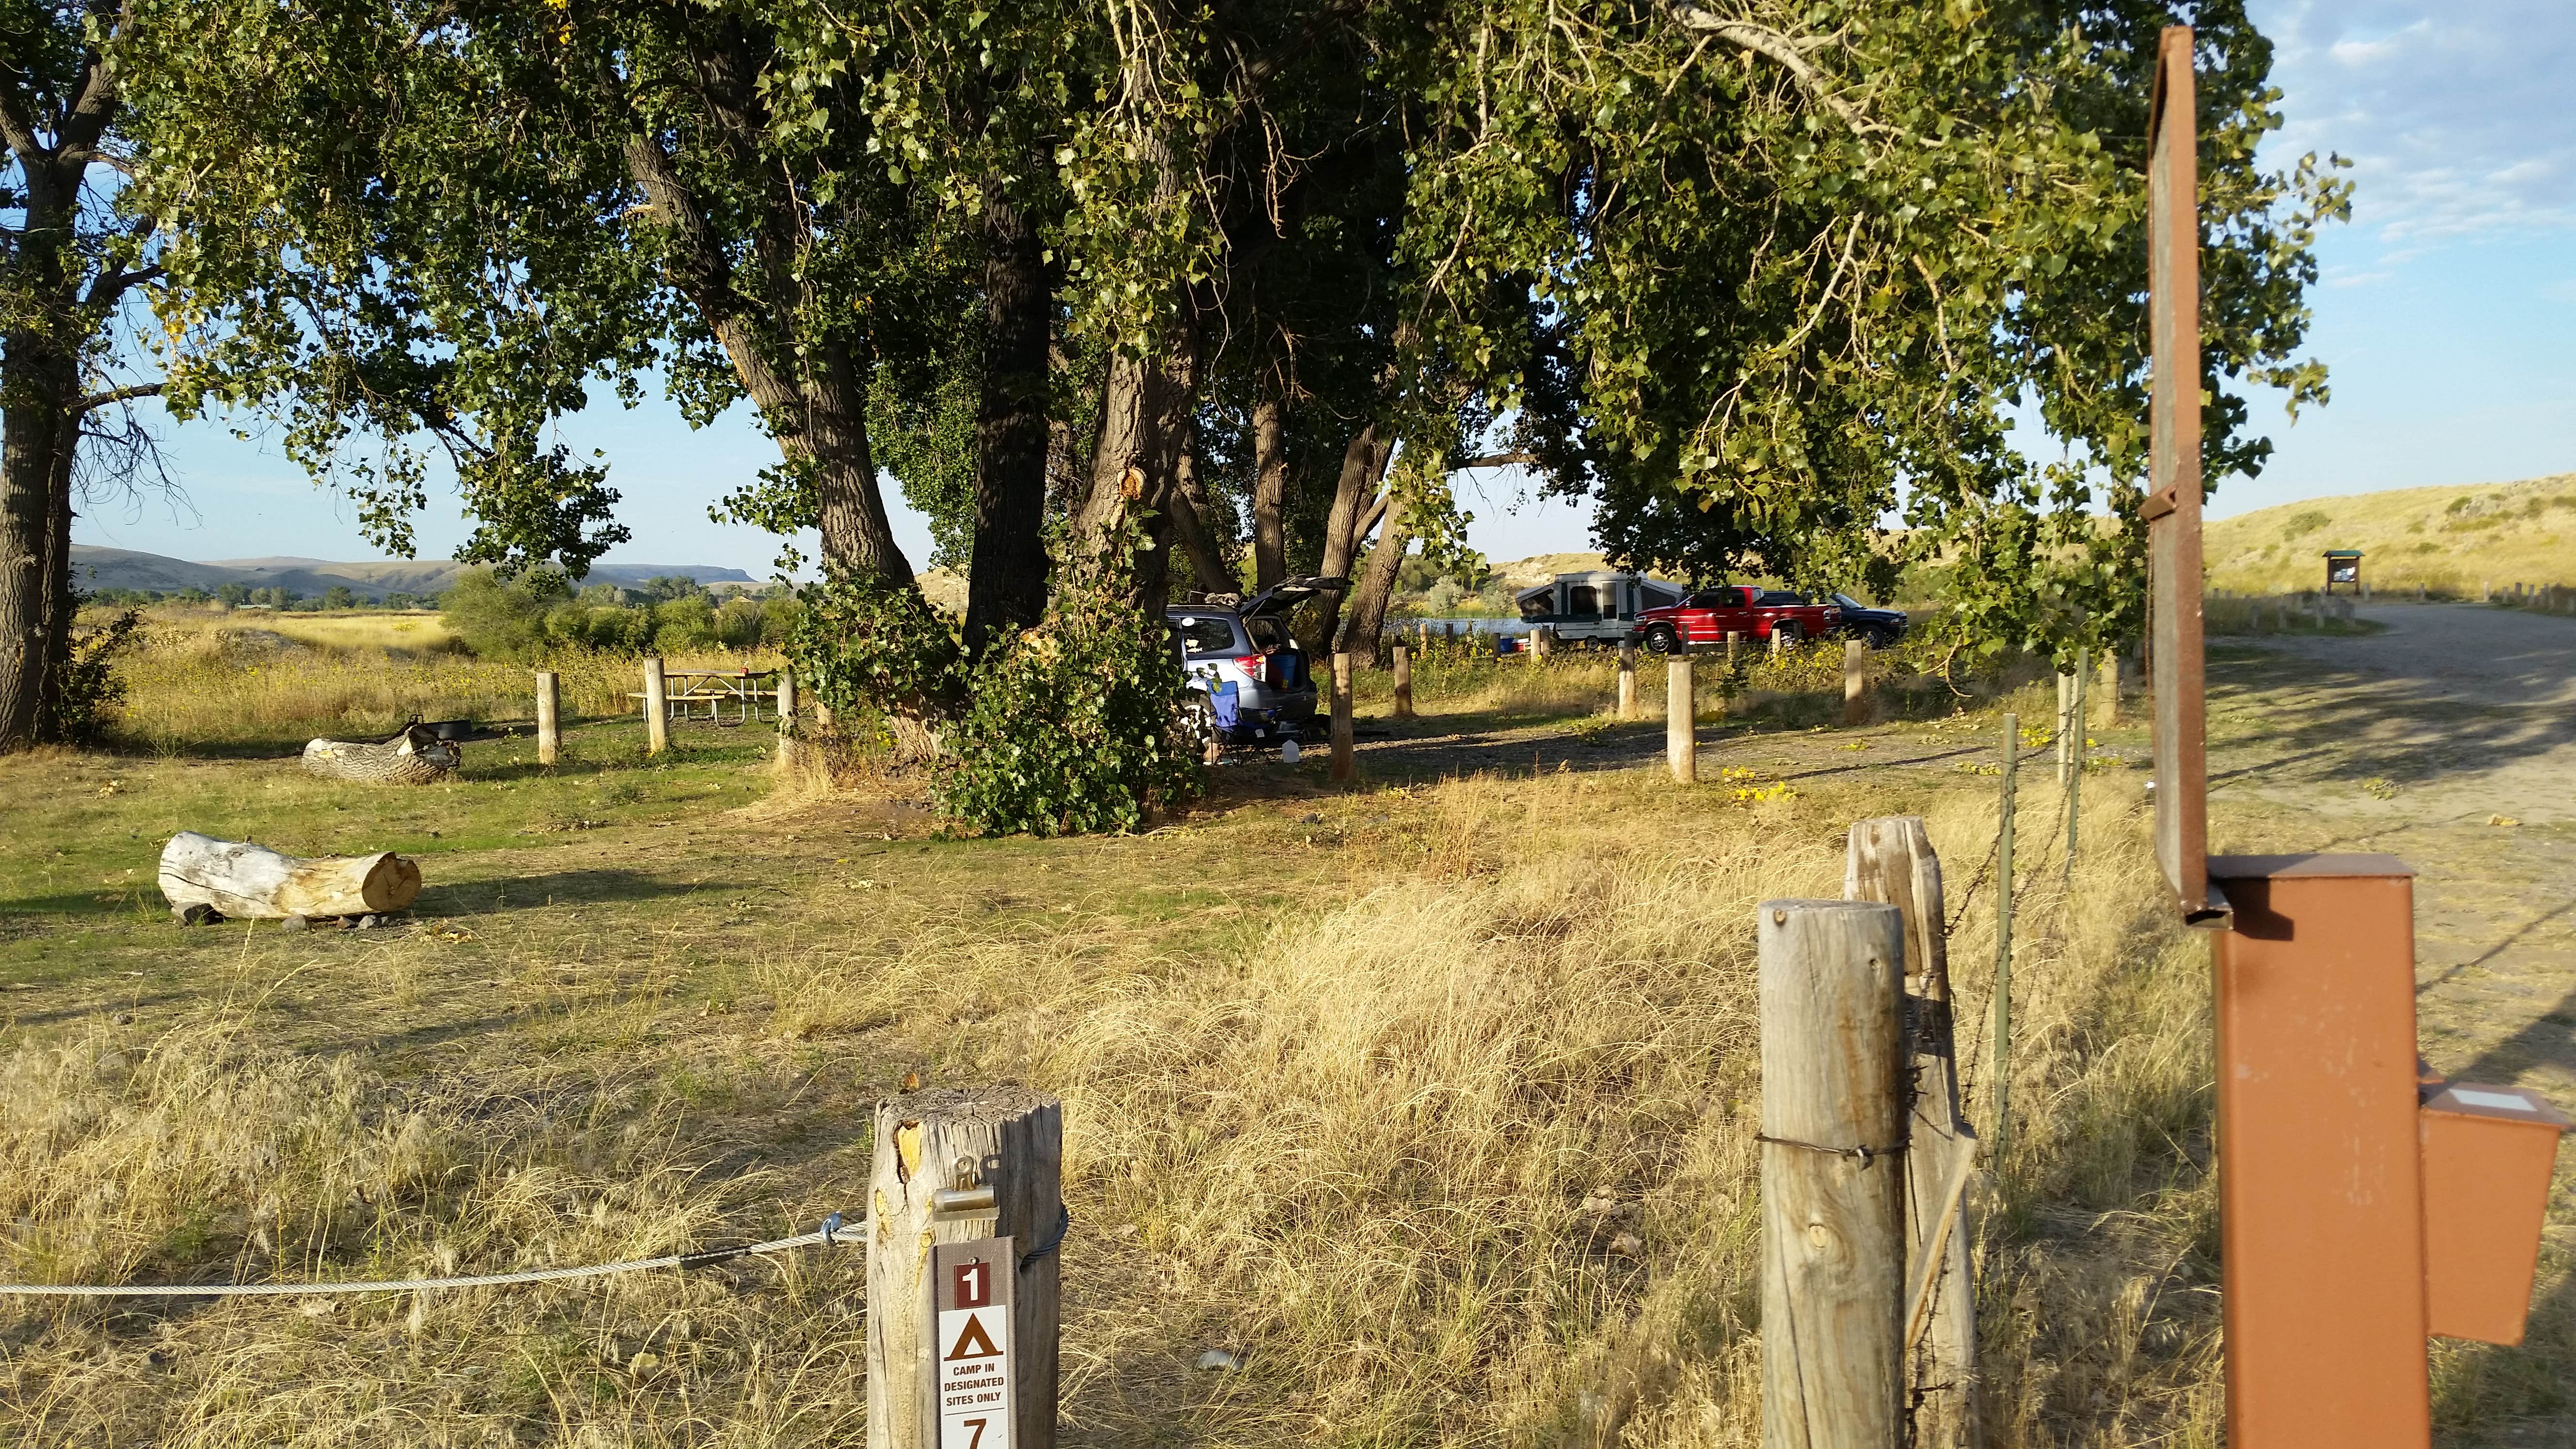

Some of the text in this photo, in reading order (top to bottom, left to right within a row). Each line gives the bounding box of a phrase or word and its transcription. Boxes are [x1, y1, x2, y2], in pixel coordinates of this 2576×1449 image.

[962, 1268, 978, 1301] 1
[953, 1363, 995, 1376] CAMP IN
[944, 1377, 1004, 1392] DESIGNATED
[947, 1392, 1001, 1406] SITES ONLY
[964, 1418, 986, 1449] 7
